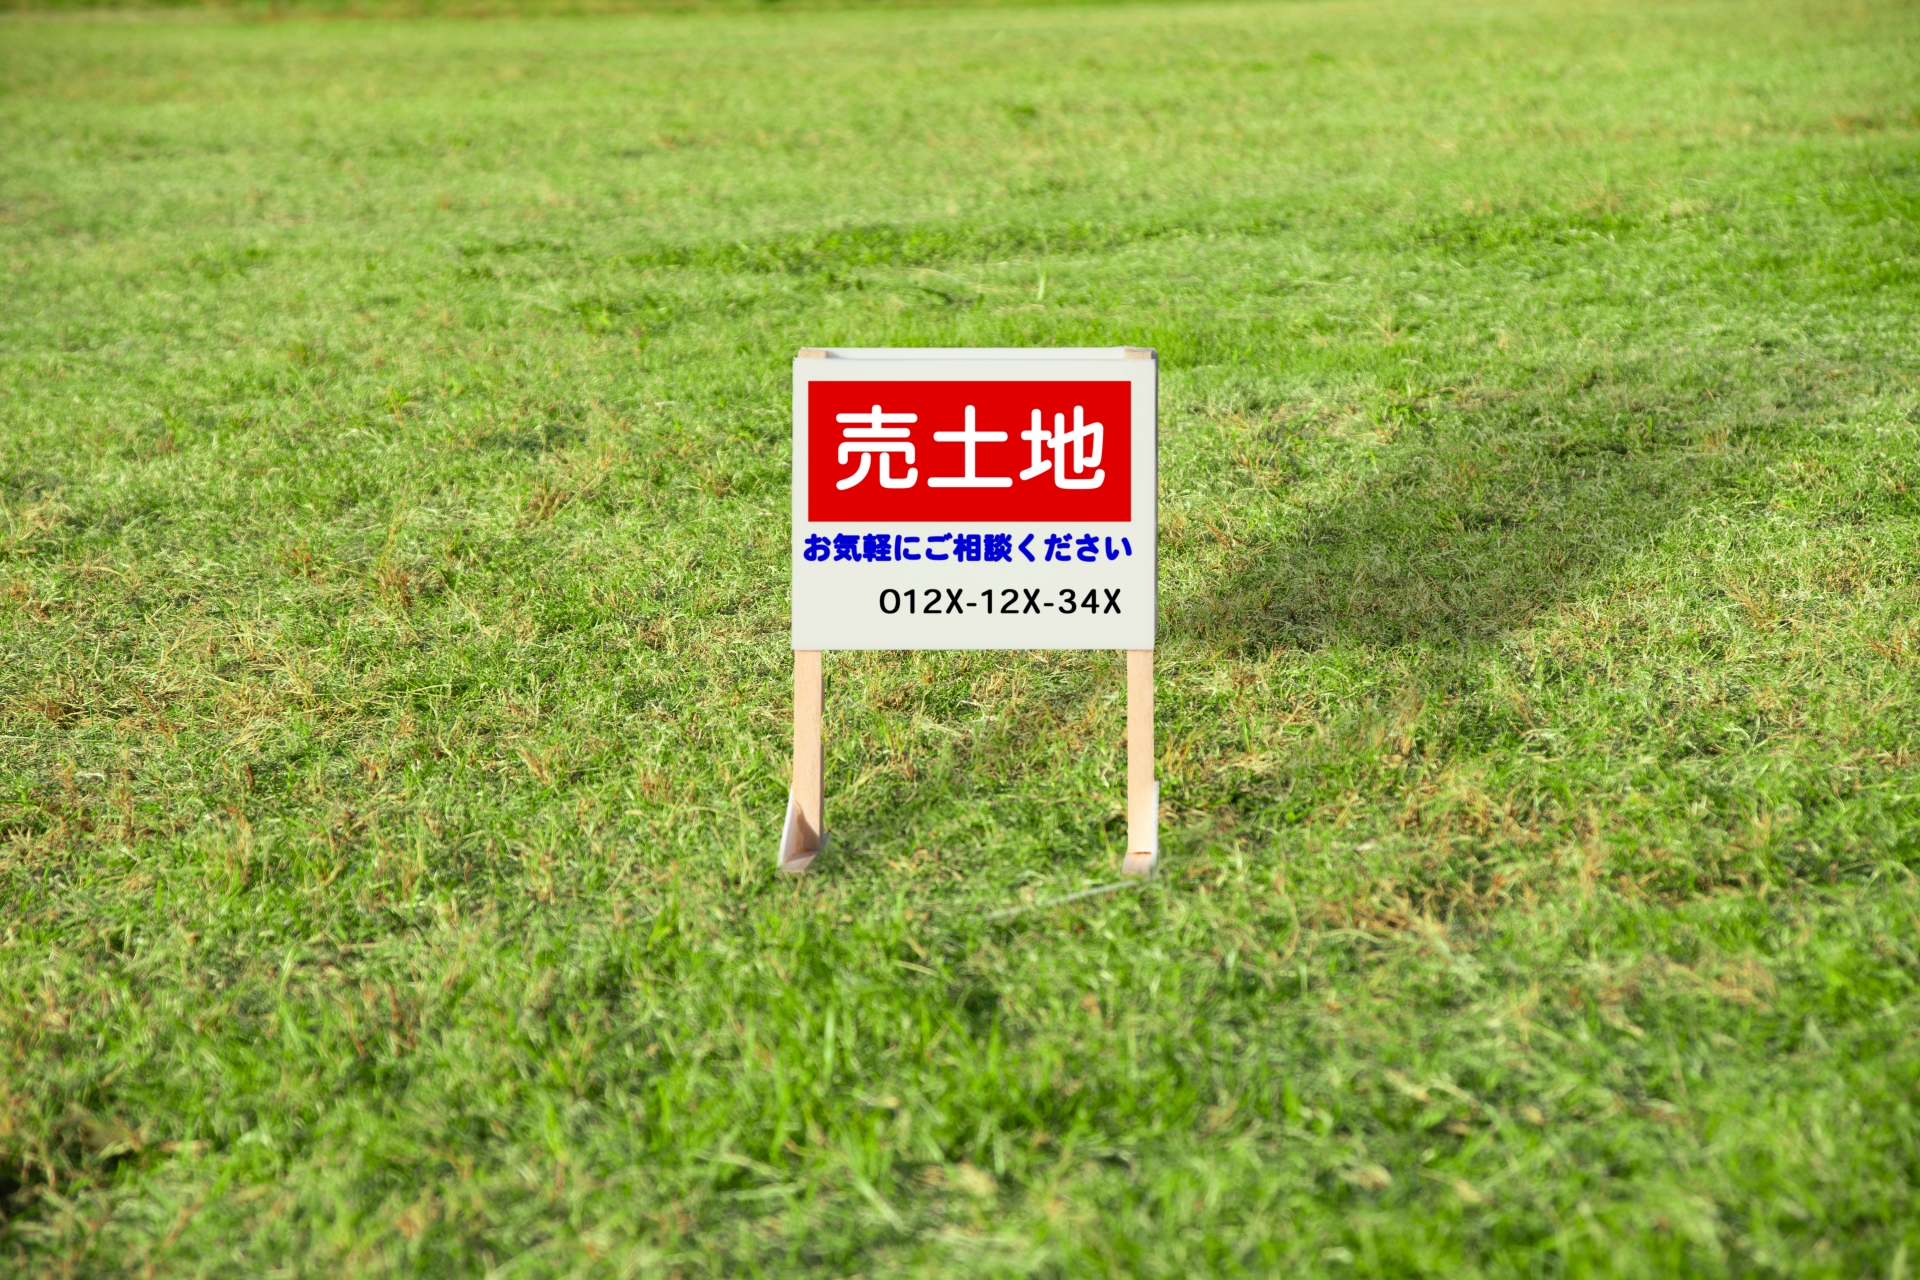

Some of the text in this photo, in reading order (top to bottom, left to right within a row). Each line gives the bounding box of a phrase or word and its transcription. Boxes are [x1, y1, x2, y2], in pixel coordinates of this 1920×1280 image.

[836, 405, 1105, 490] 売土地
[804, 533, 1132, 562] お気軽にご相談ください
[880, 589, 1121, 614] 012X-12X-34X
